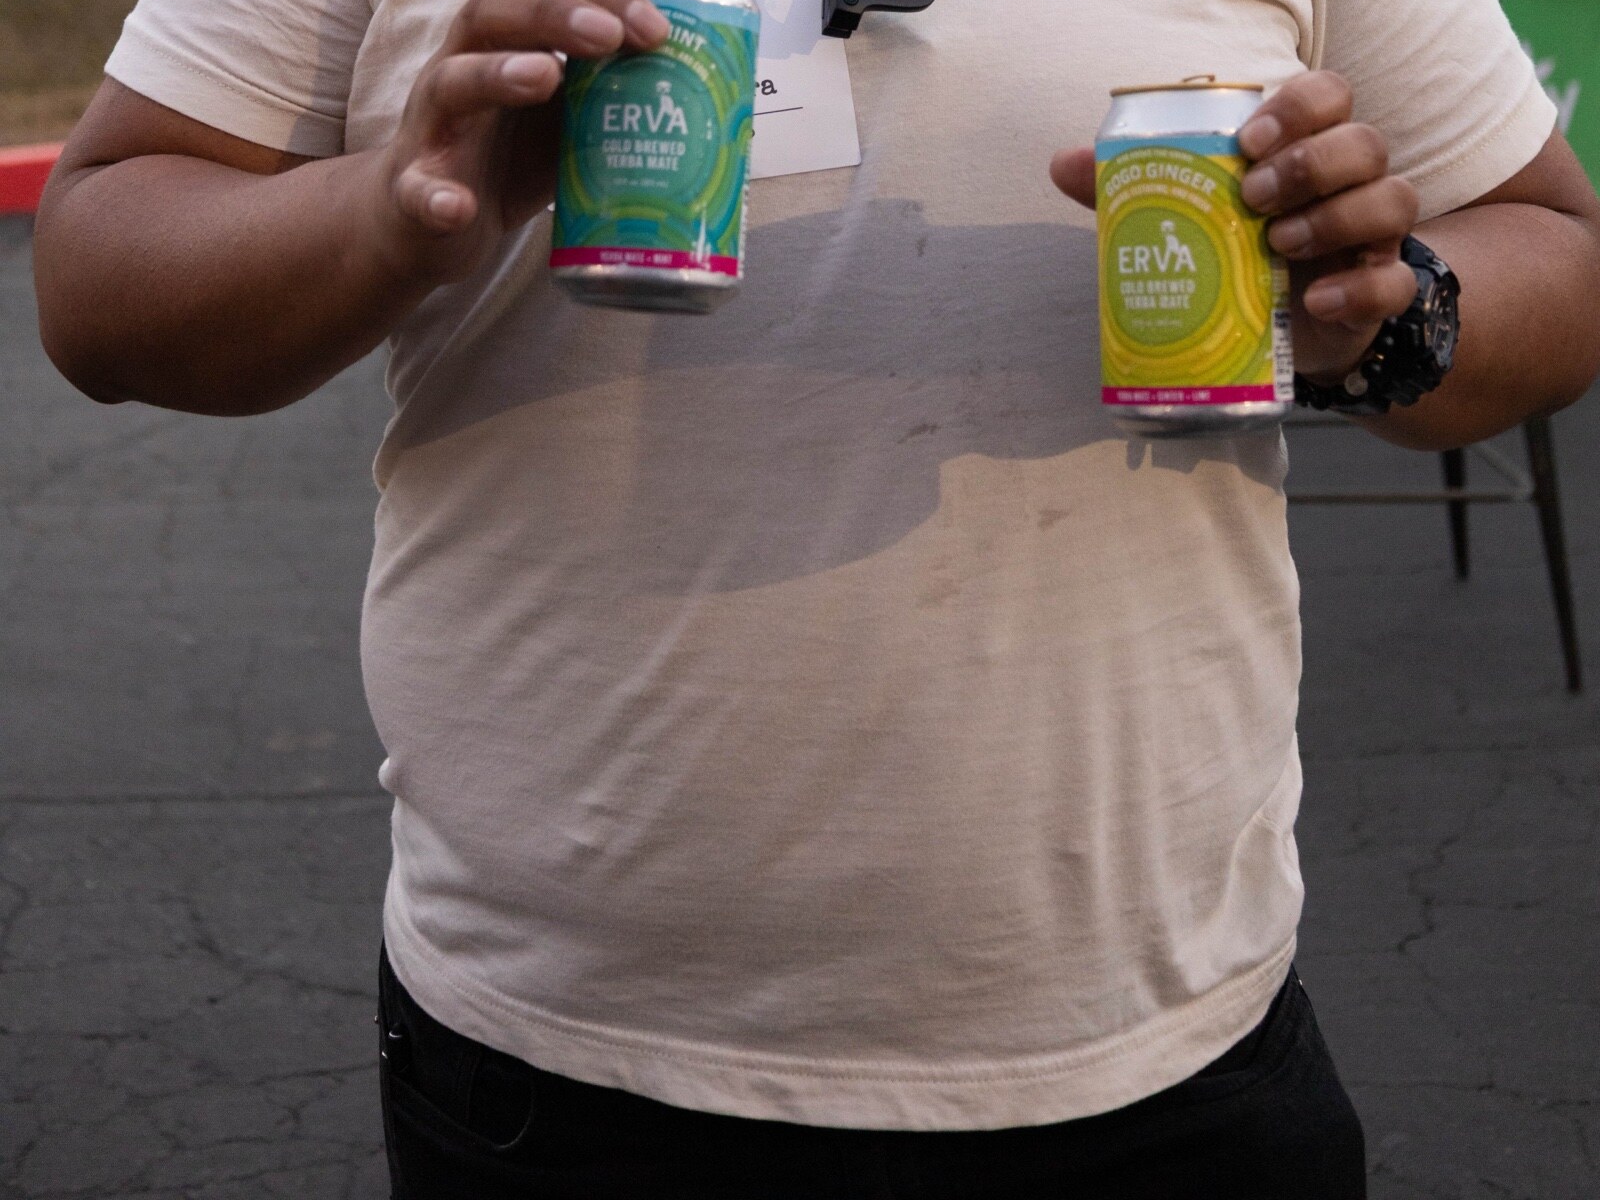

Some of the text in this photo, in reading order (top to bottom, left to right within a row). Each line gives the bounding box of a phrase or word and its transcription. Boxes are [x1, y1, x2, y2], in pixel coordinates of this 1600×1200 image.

[602, 103, 689, 136] ERVA
[647, 156, 679, 171] MATE
[1105, 162, 1217, 197] GOGO GINGER
[1117, 245, 1197, 274] ERVA
